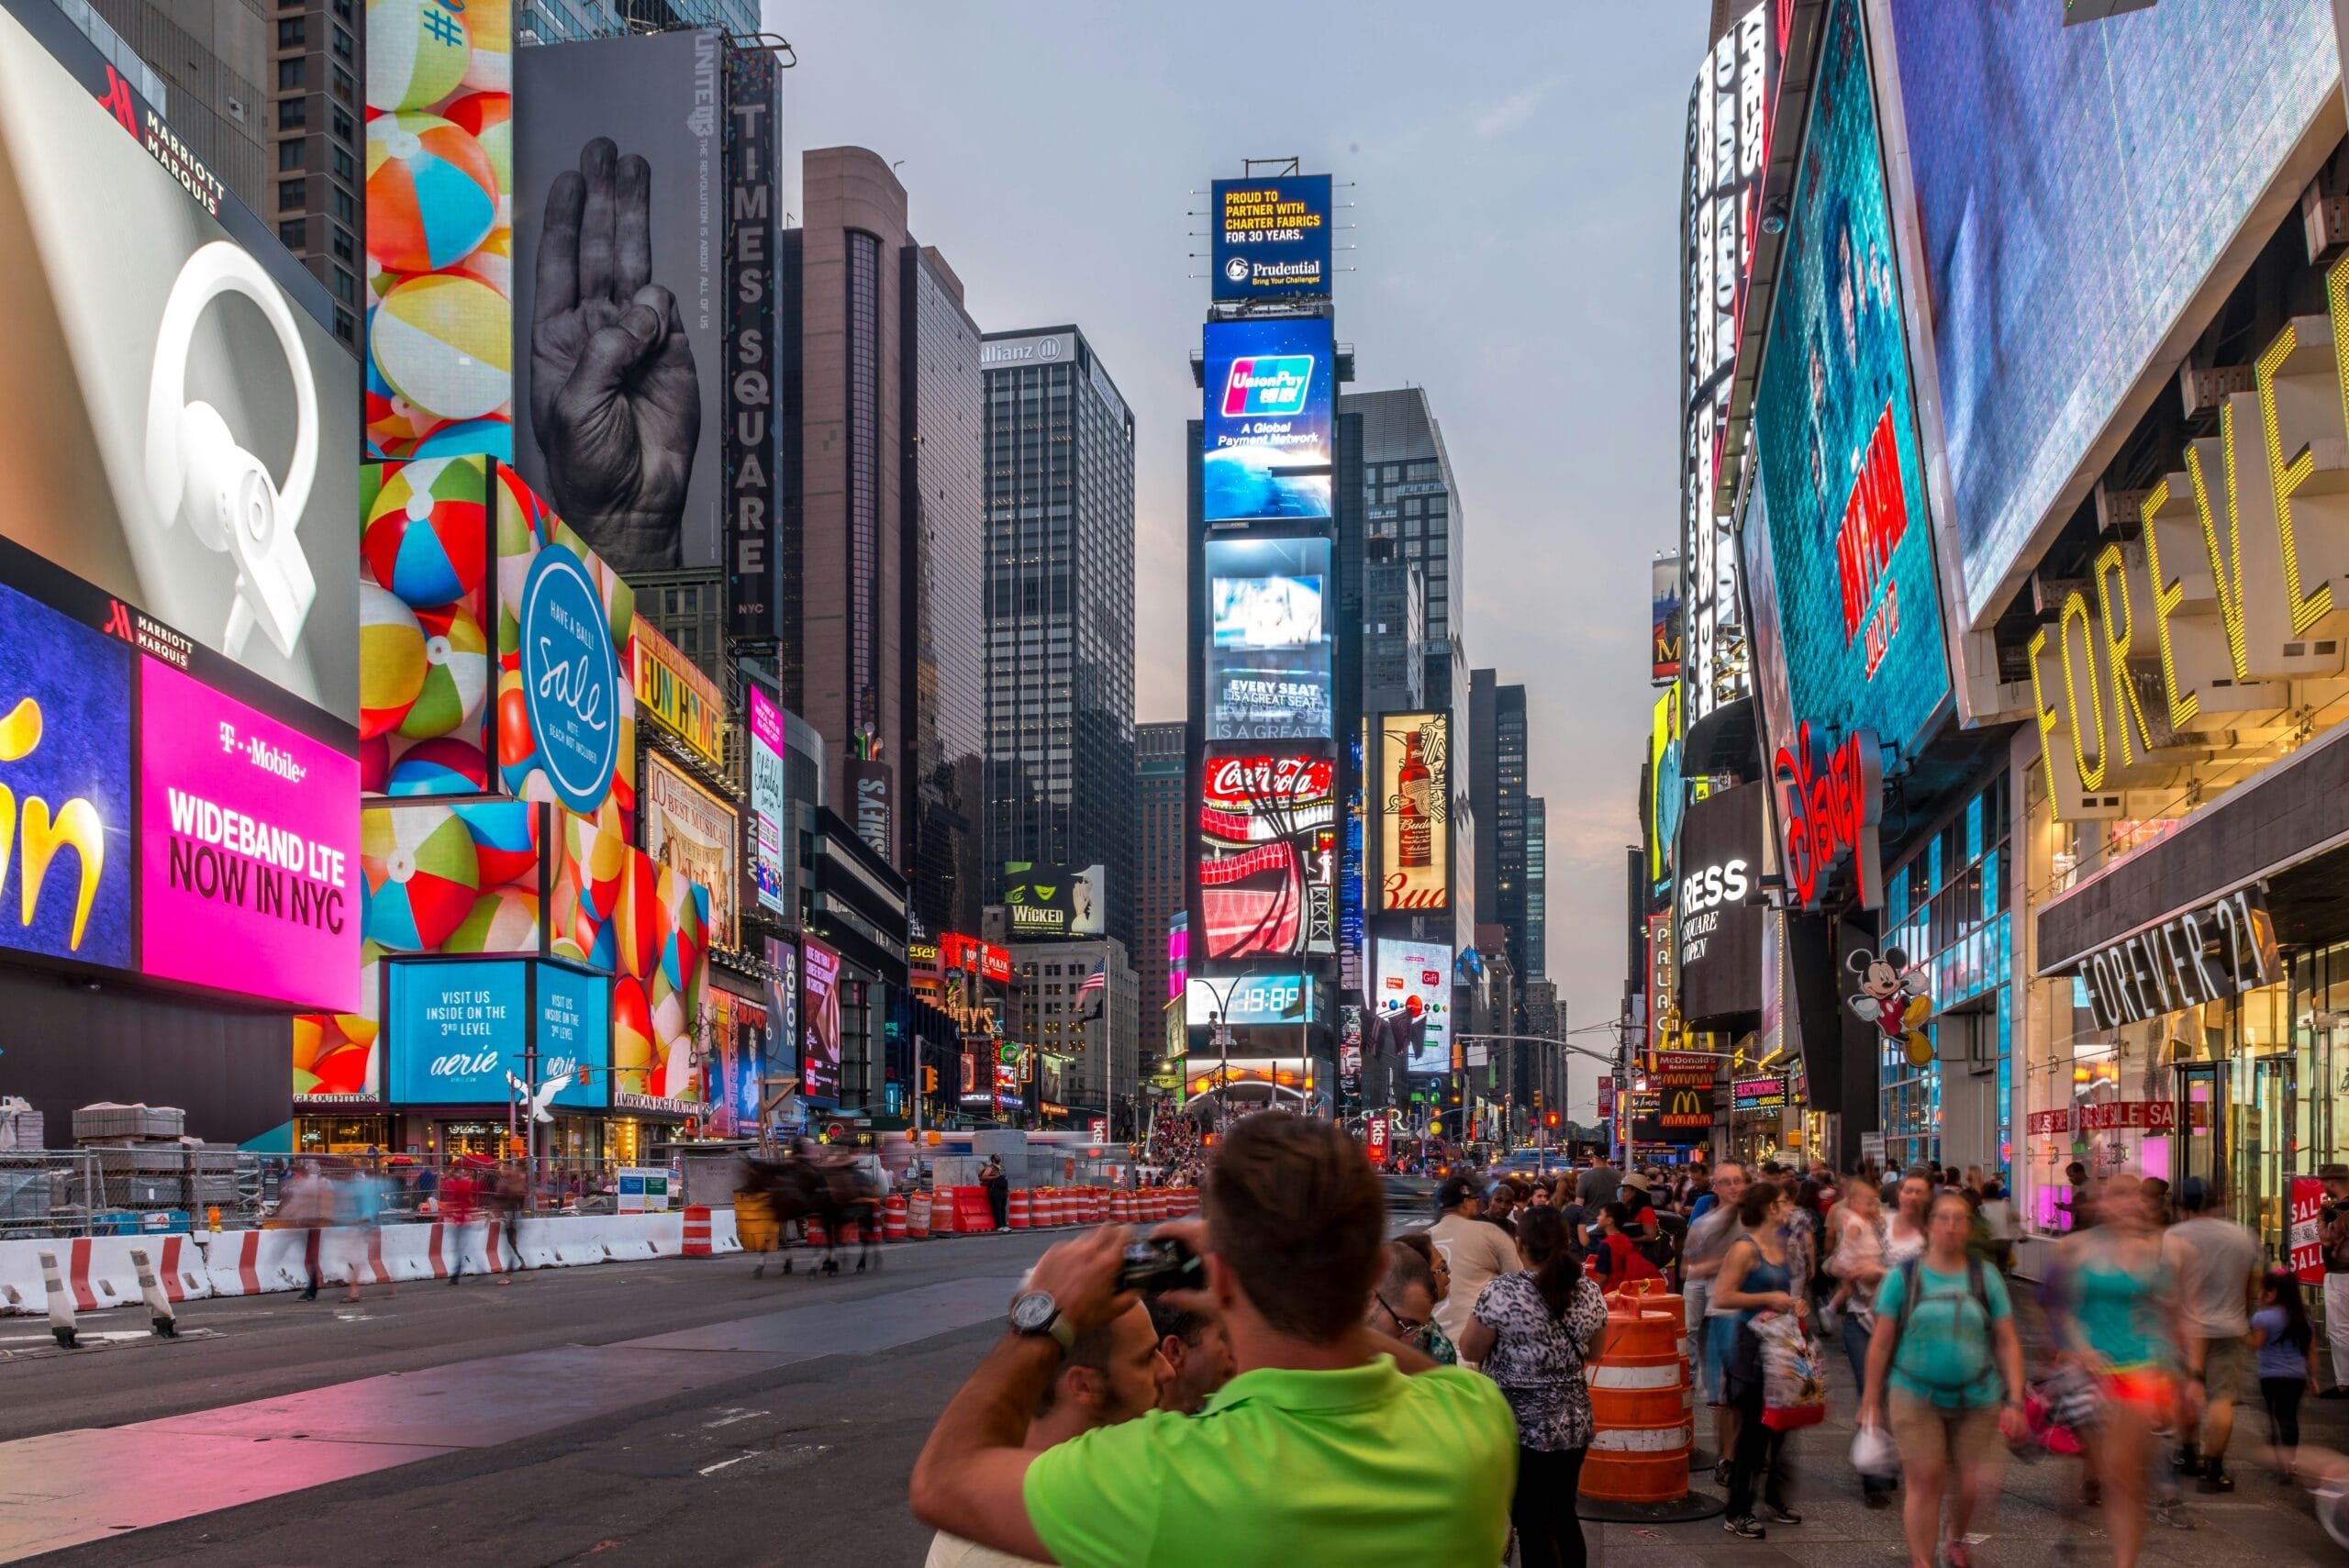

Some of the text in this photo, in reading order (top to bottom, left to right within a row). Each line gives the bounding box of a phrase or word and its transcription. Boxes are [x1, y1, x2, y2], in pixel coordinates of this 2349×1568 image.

[1742, 1, 1765, 177] XPRESS
[147, 111, 225, 201] MARRIOTT
[147, 136, 217, 217] MARQUIS
[734, 104, 767, 304] TIMES
[1226, 191, 1278, 205] PROUD TO
[1226, 202, 1305, 217] PARTNER WITH
[1226, 215, 1320, 230] CHARTER FABRICS
[699, 139, 709, 329] THE REVOLUTION IS ABOUT ALL OF US
[1226, 228, 1303, 243] FOR 30 YEARS.
[1252, 261, 1319, 276] Prudential
[1233, 371, 1305, 389] UnionPay
[1241, 422, 1291, 434] A Global
[734, 328, 770, 573] SQUARE
[1219, 432, 1319, 448] Payment Network
[2028, 257, 2349, 822] FOREVE
[739, 604, 763, 614] NYC
[139, 617, 193, 654] MARRIOTT
[551, 599, 595, 651] HAVE A BALL!
[139, 632, 188, 668] MARQUIS
[1865, 601, 1887, 683] JULY
[540, 637, 607, 730] Sale
[1231, 680, 1319, 695] EVERY SEAT
[641, 648, 673, 721] FUN
[679, 681, 718, 759] HOME
[1231, 691, 1318, 708] IS A GREAT SEAT
[566, 735, 575, 751] NOT
[575, 741, 597, 764] INCLUDED
[668, 794, 689, 824] BEST
[692, 809, 730, 849] MUSICAL
[1776, 719, 1865, 911] Disney
[168, 786, 345, 888] WIDEBAND LTE
[747, 816, 758, 883] NEW
[170, 836, 344, 935] NOW IN NYC
[909, 946, 937, 958] ese's
[2078, 891, 2269, 1032] FOREVER 21
[989, 956, 1008, 972] PLAZA
[1423, 973, 1437, 983] Gift
[441, 991, 490, 1005] VISIT US
[551, 995, 573, 1010] VISIT US
[786, 952, 796, 1047] SOLO 2
[427, 1006, 507, 1020] INSIDE ON THE
[544, 1007, 579, 1027] INSIDE ON THE
[441, 1022, 492, 1036] 3RD LEVEL
[560, 1027, 573, 1040] LEVEL
[430, 1044, 498, 1076] aerie
[546, 1050, 576, 1076] aerie
[1659, 1056, 1716, 1064] McDonald's
[294, 1094, 377, 1103] GLE OUTFITTERS
[1736, 1080, 1783, 1097] ELECTRONICS
[617, 1092, 653, 1109] AMERICAN
[654, 1097, 674, 1112] EAGLE
[1737, 1096, 1782, 1107] CAMERA LUGGAGE
[1093, 1120, 1107, 1145] tkts
[1372, 1119, 1386, 1146] tkts
